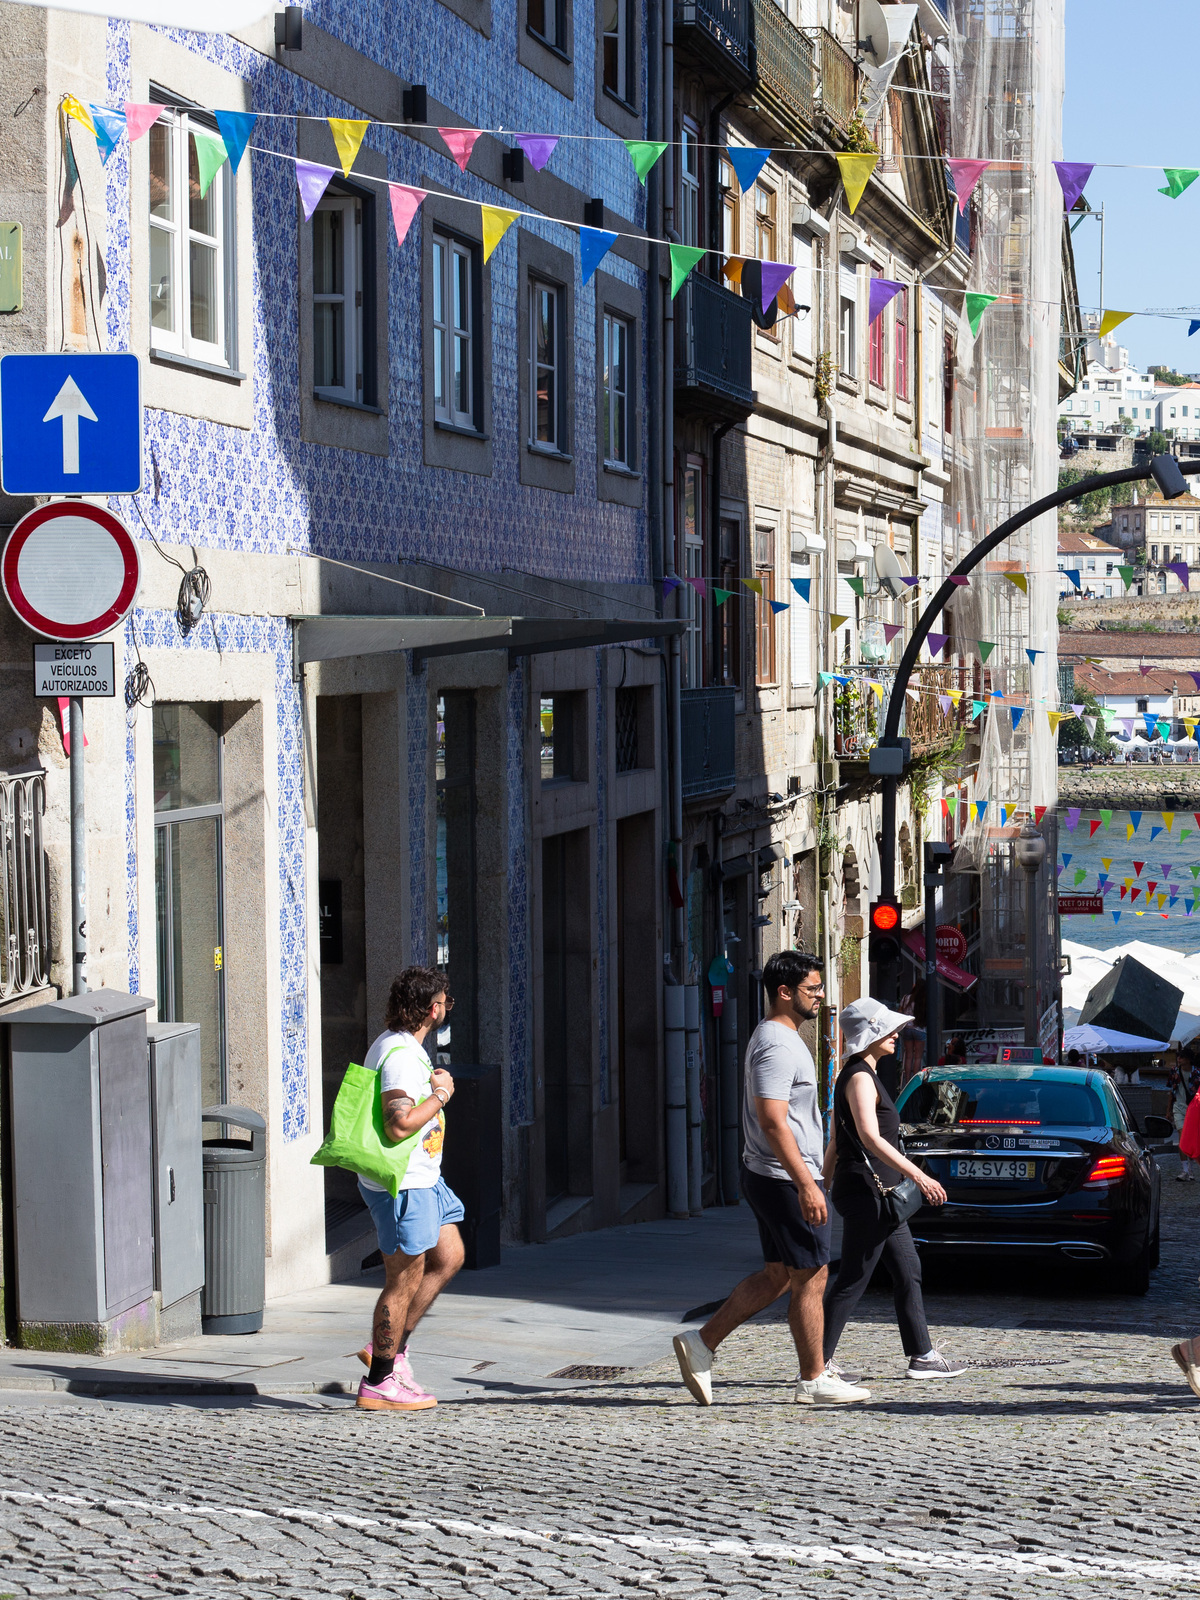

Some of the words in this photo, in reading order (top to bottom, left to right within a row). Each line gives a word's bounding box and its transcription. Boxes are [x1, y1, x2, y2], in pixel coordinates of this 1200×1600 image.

[54, 648, 92, 660] EXCETO
[50, 662, 97, 676] VEÍCULOS
[41, 680, 108, 692] AUTORIZADOS
[1002, 1049, 1011, 1060] 3
[1012, 1050, 1033, 1059] TAXI
[1005, 1138, 1014, 1147] 08
